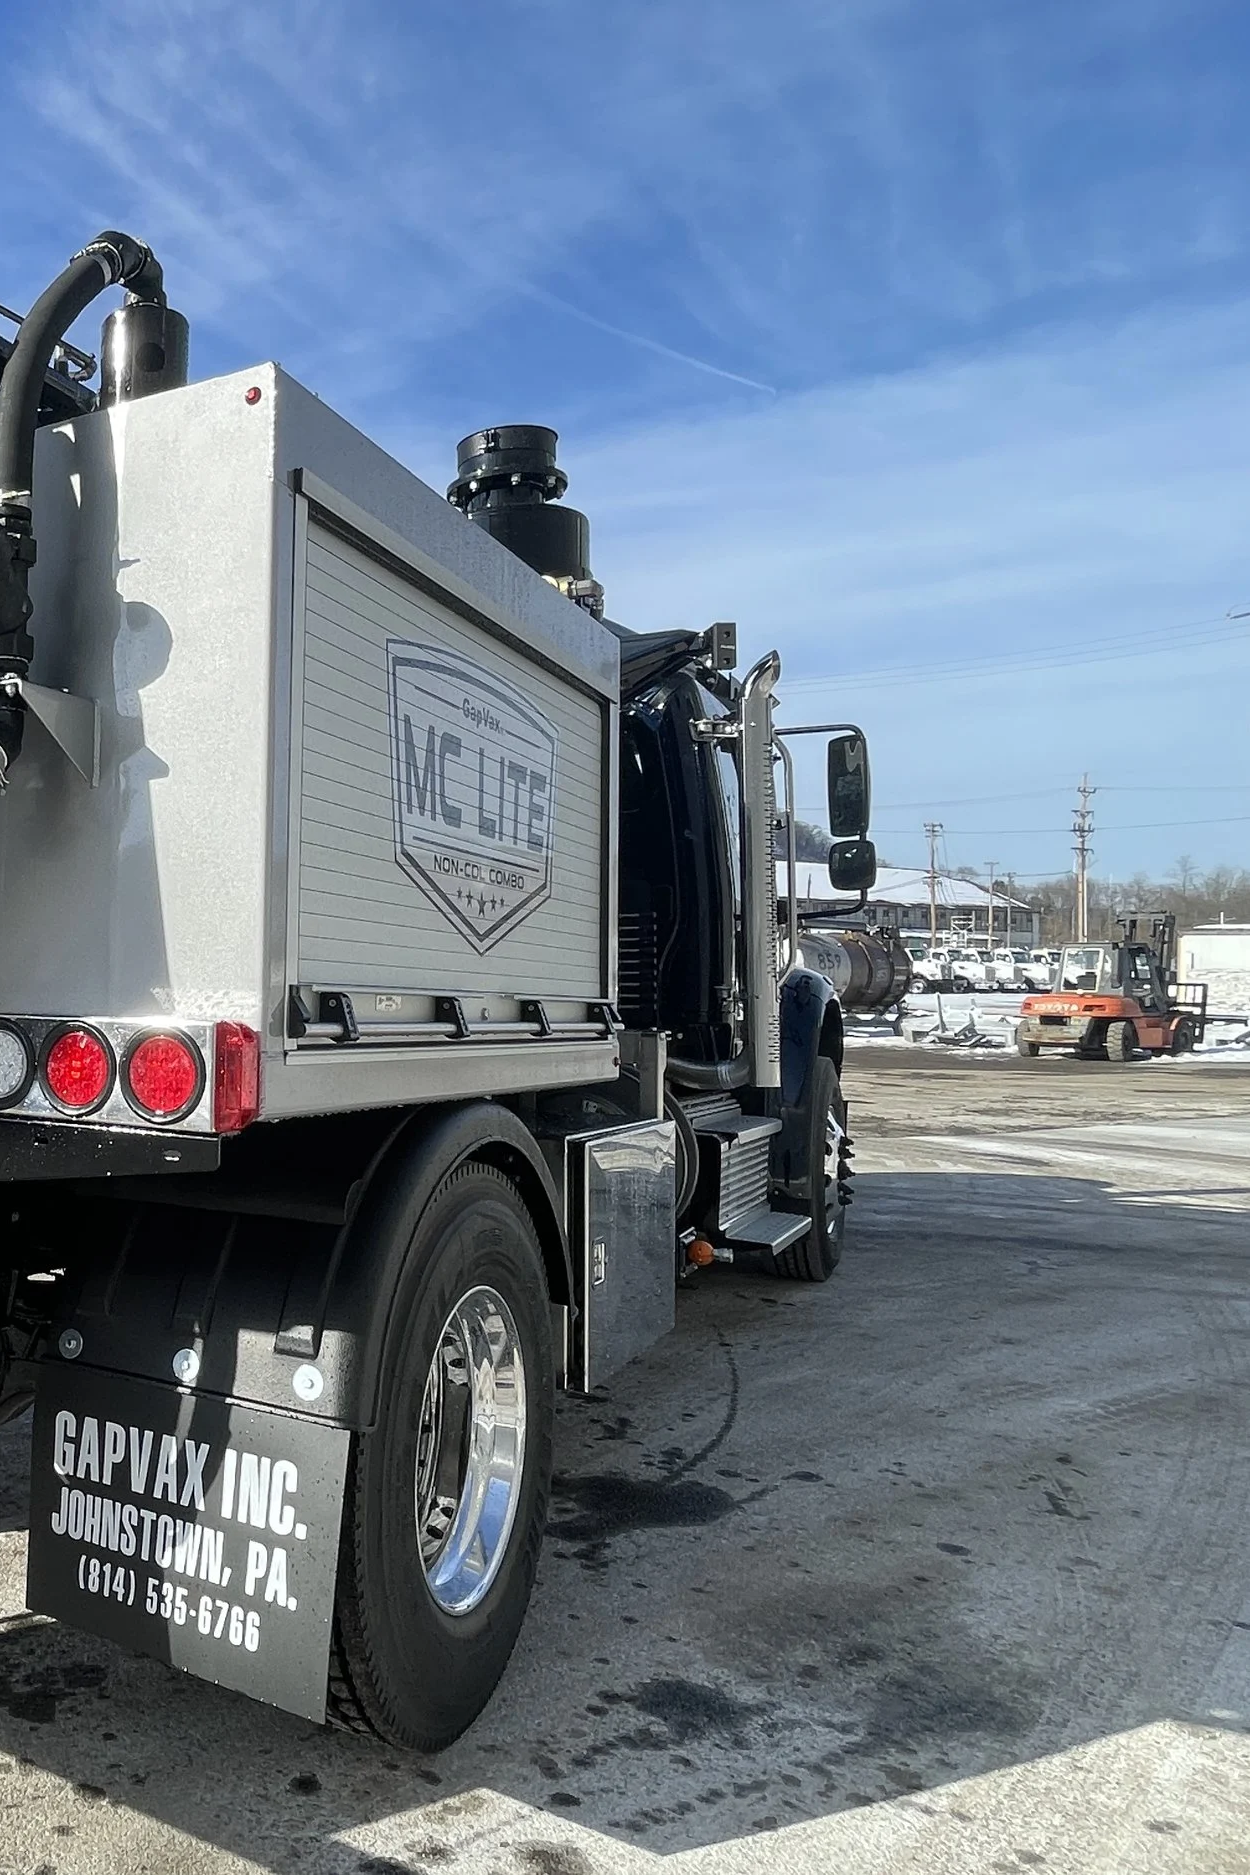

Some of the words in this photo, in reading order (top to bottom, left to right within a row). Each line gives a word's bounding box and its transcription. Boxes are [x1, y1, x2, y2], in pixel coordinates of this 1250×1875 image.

[403, 713, 463, 829] MC
[479, 747, 547, 853] LITE
[433, 854, 485, 880] NON-CDL
[489, 868, 525, 890] COMBO
[817, 953, 841, 970] 859
[53, 1410, 210, 1512] GAPVAX
[220, 1448, 308, 1540] INC.
[51, 1486, 232, 1588] JOHNSTOWN,
[244, 1540, 299, 1611] PA.
[78, 1554, 136, 1606] (814)
[145, 1577, 261, 1652] 535-6766
